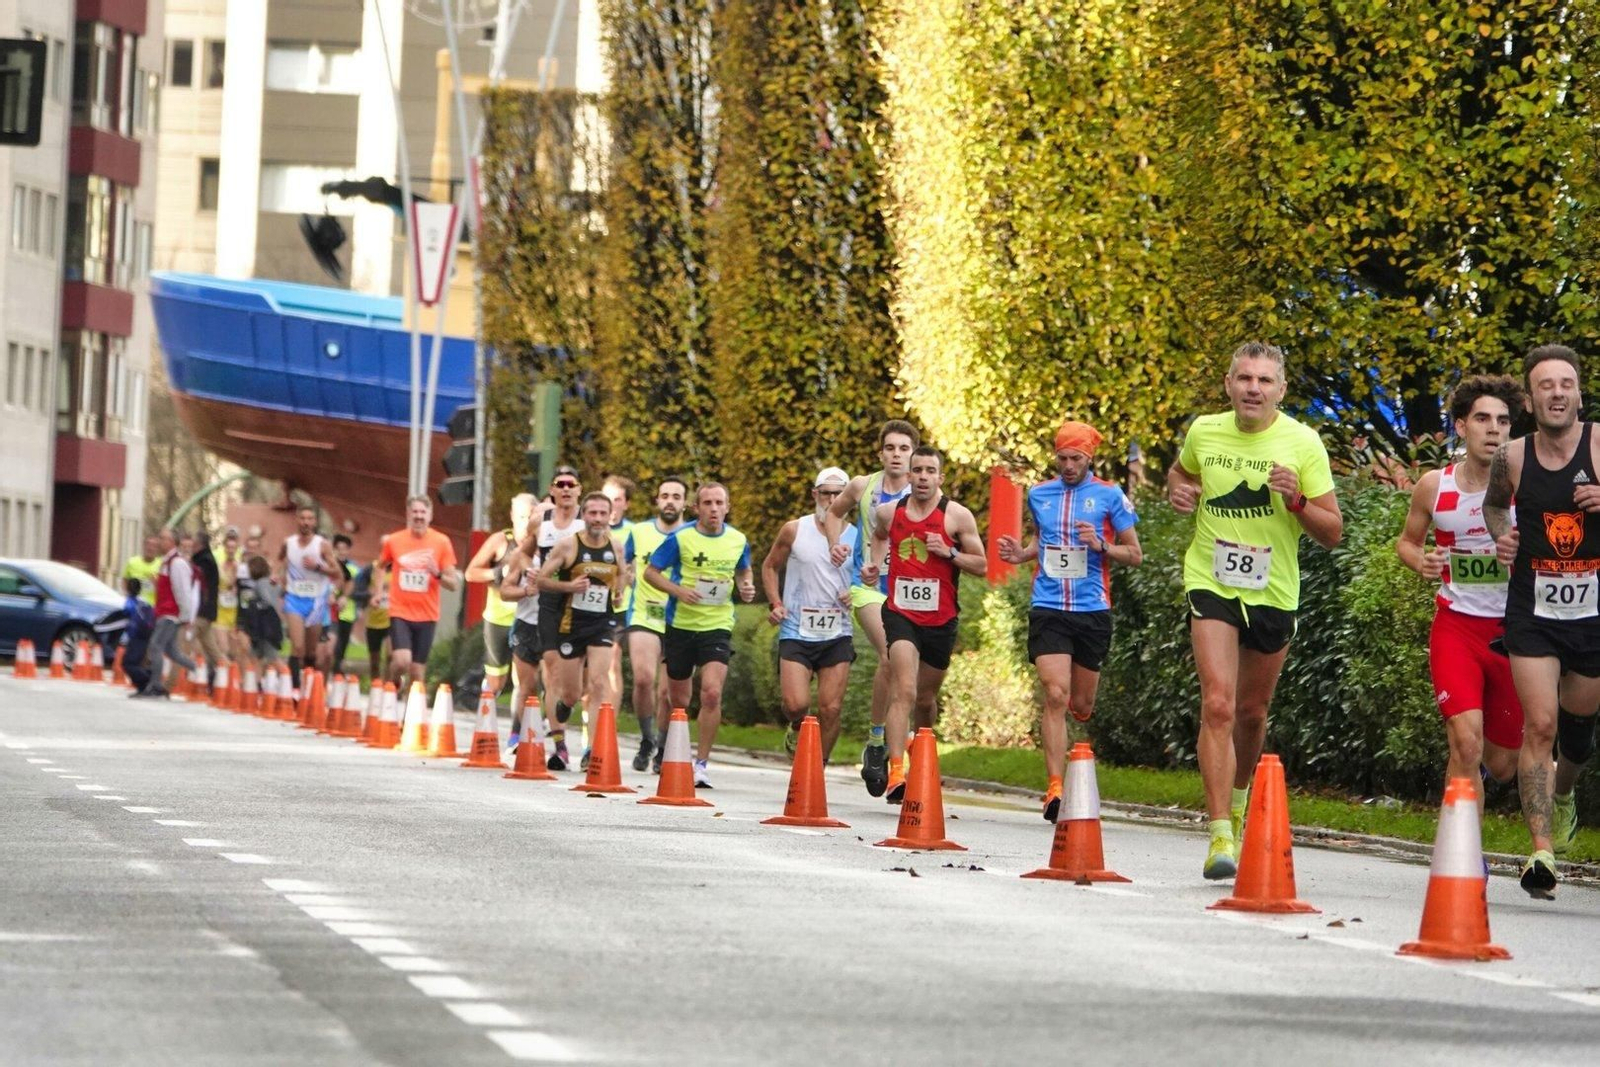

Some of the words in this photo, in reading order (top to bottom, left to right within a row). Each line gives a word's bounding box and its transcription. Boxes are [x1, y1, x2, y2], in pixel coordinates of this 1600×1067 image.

[1204, 454, 1233, 469] máis
[1205, 504, 1274, 519] RUNNING
[1060, 554, 1069, 568] 5
[1225, 552, 1254, 574] 58
[1458, 559, 1499, 578] 504
[582, 591, 604, 604] 152
[709, 586, 717, 597] 4
[903, 585, 931, 600] 168
[1545, 583, 1590, 605] 207
[808, 616, 836, 629] 147
